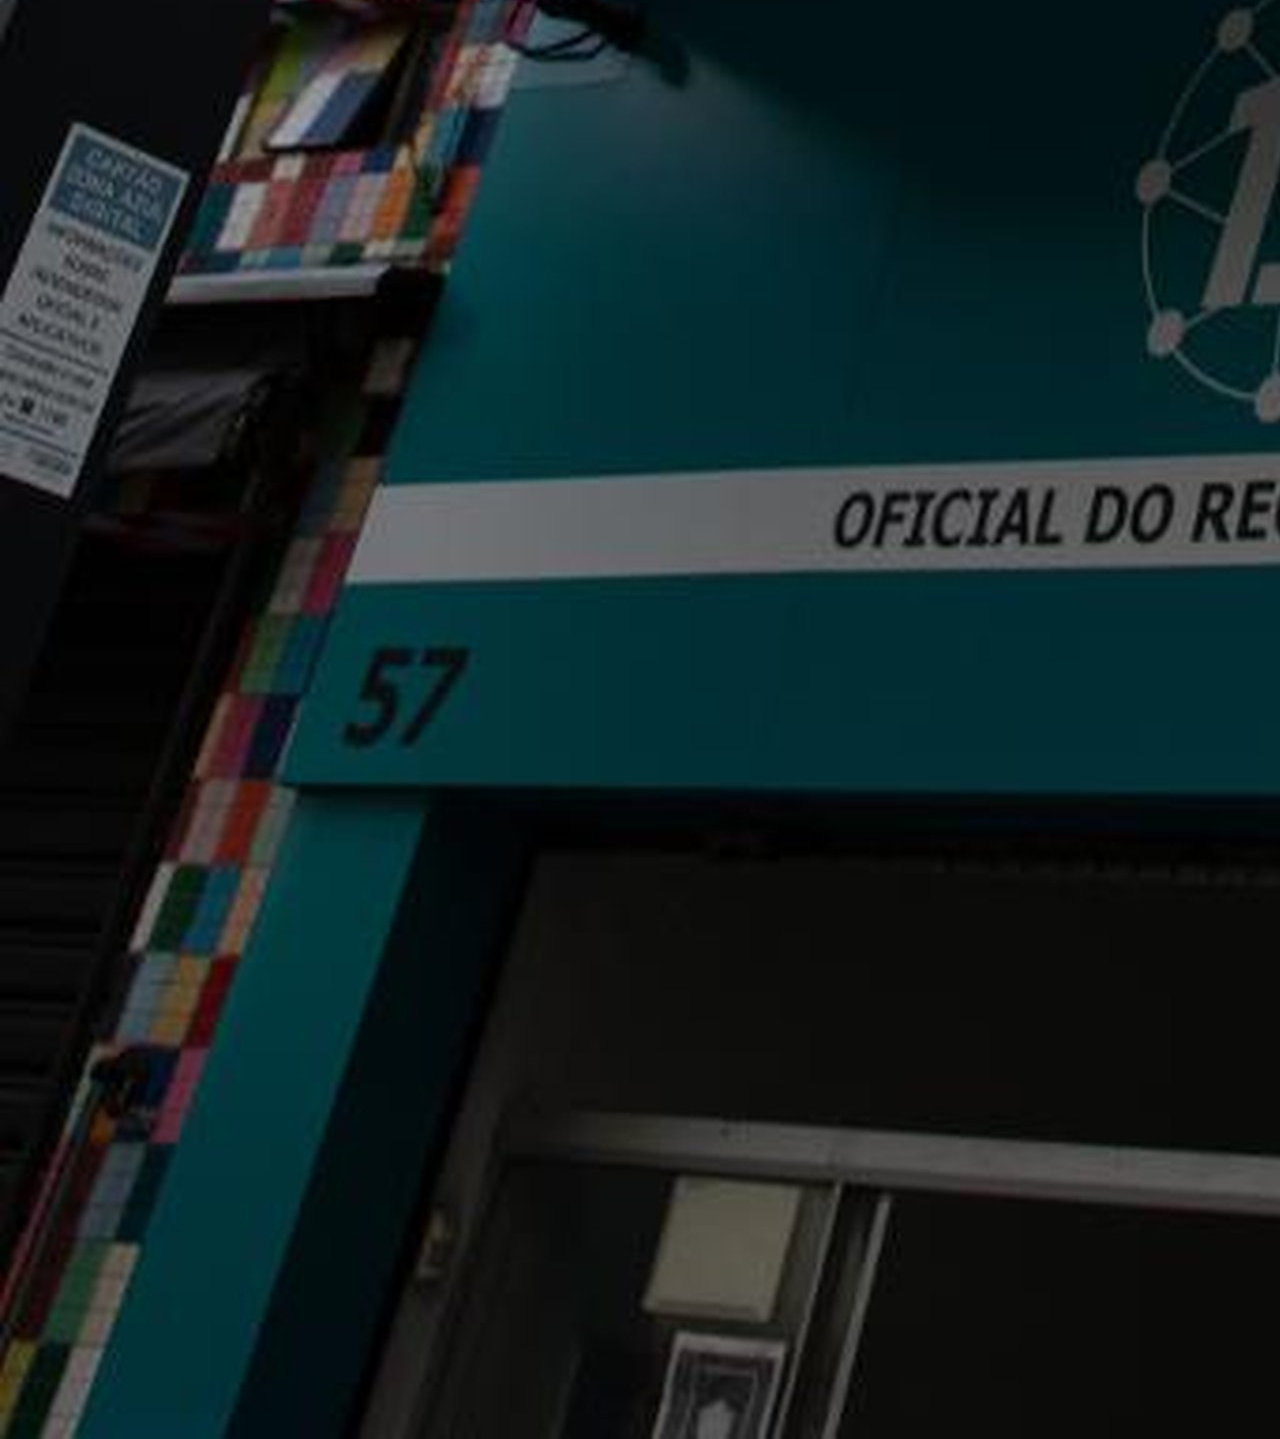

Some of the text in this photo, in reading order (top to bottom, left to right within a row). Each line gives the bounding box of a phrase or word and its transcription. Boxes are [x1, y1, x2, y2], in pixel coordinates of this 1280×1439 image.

[833, 487, 1063, 549] OFICIAL
[1084, 483, 1175, 544] DO
[342, 646, 471, 748] 57
